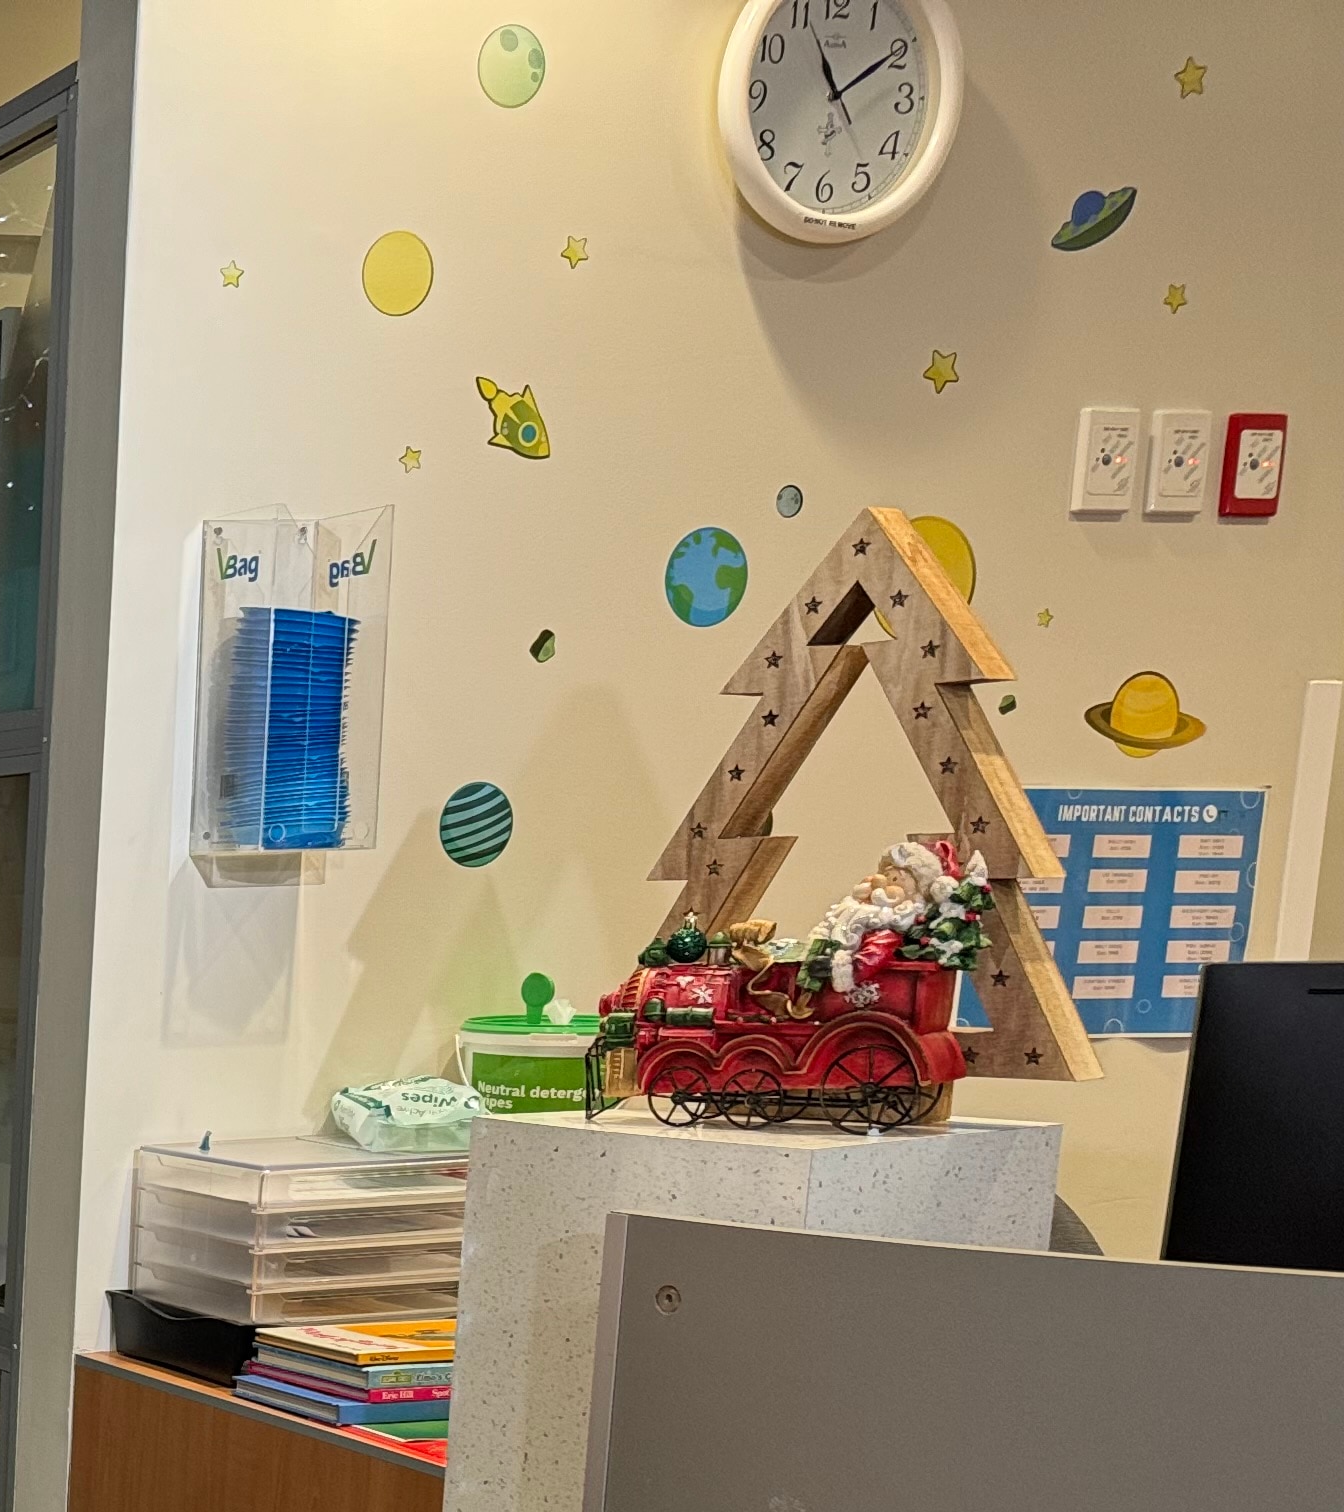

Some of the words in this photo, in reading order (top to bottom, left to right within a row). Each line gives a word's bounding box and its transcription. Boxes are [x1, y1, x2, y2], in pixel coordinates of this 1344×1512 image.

[791, 0, 810, 29] 11
[824, 0, 850, 20] 12
[870, 1, 879, 31] 1
[760, 33, 785, 64] 10
[888, 38, 909, 70] 2
[749, 79, 768, 113] 9
[894, 82, 914, 114] 3
[757, 129, 775, 161] 8
[878, 130, 901, 160] 4
[783, 162, 804, 192] 7
[815, 169, 834, 203] 6
[851, 163, 871, 193] 5
[1057, 804, 1127, 822] IMPORTANT
[1128, 805, 1200, 823] CONTACTS
[477, 1080, 526, 1098] Neutral
[529, 1085, 600, 1102] deterg
[382, 1391, 399, 1400] Eric
